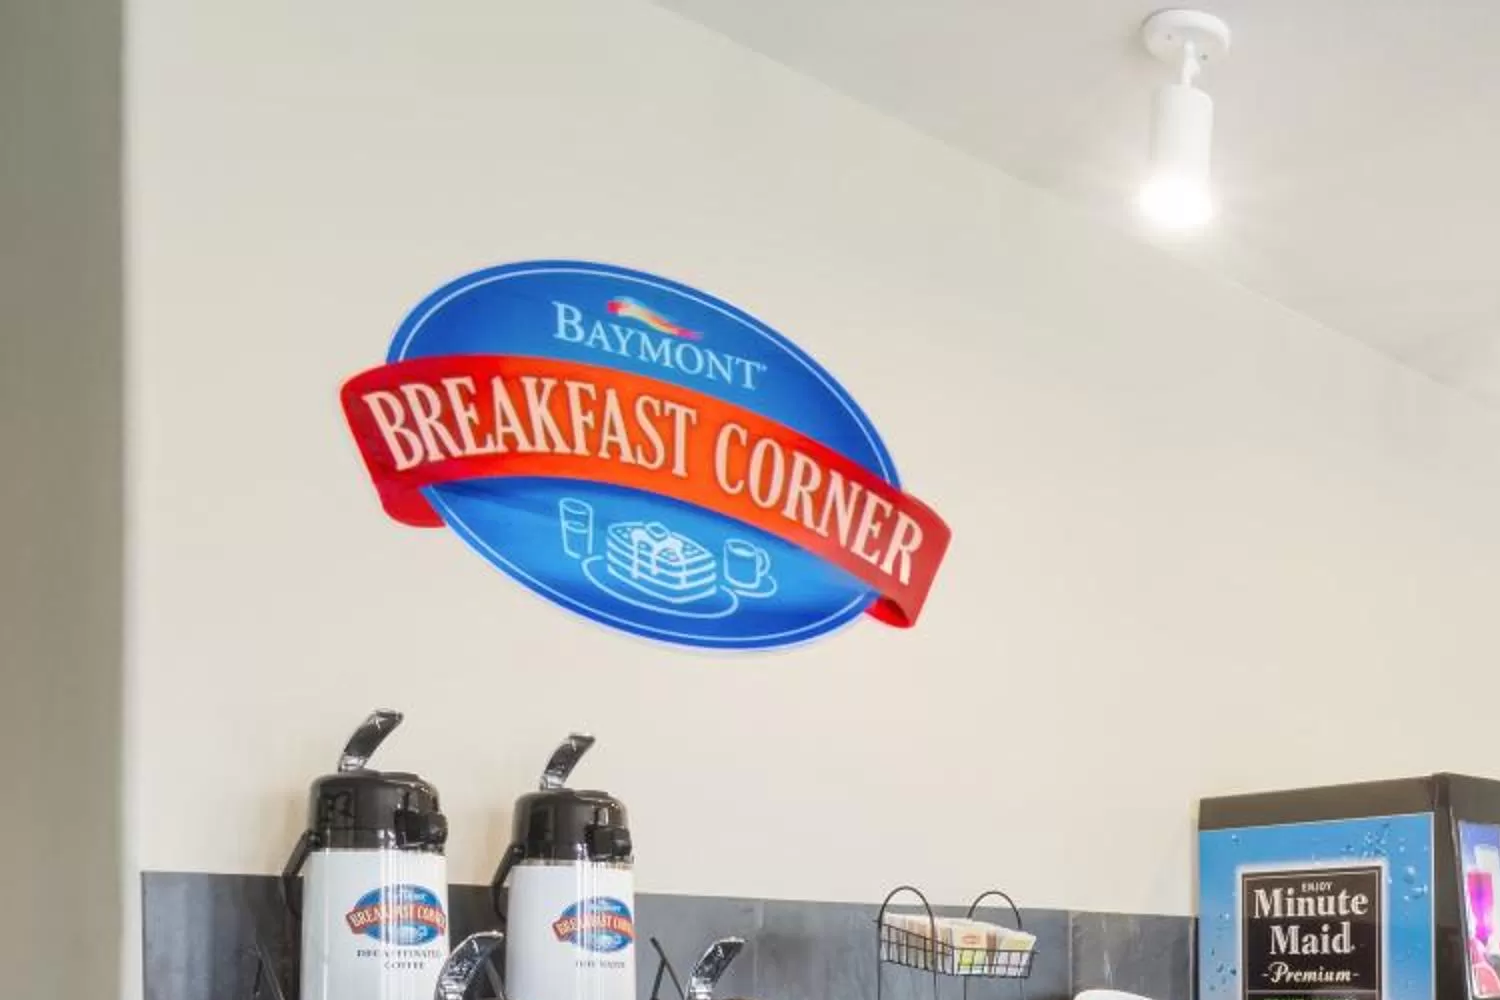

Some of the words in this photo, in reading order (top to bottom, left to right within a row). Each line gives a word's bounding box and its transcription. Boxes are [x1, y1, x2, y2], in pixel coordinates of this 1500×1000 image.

[552, 301, 763, 390] BAYMONT
[363, 375, 697, 479] BREAKFAST
[714, 423, 925, 586] CORNER
[1253, 887, 1369, 919] Minute
[1301, 881, 1333, 893] ENJOY
[1270, 921, 1352, 956] Maid
